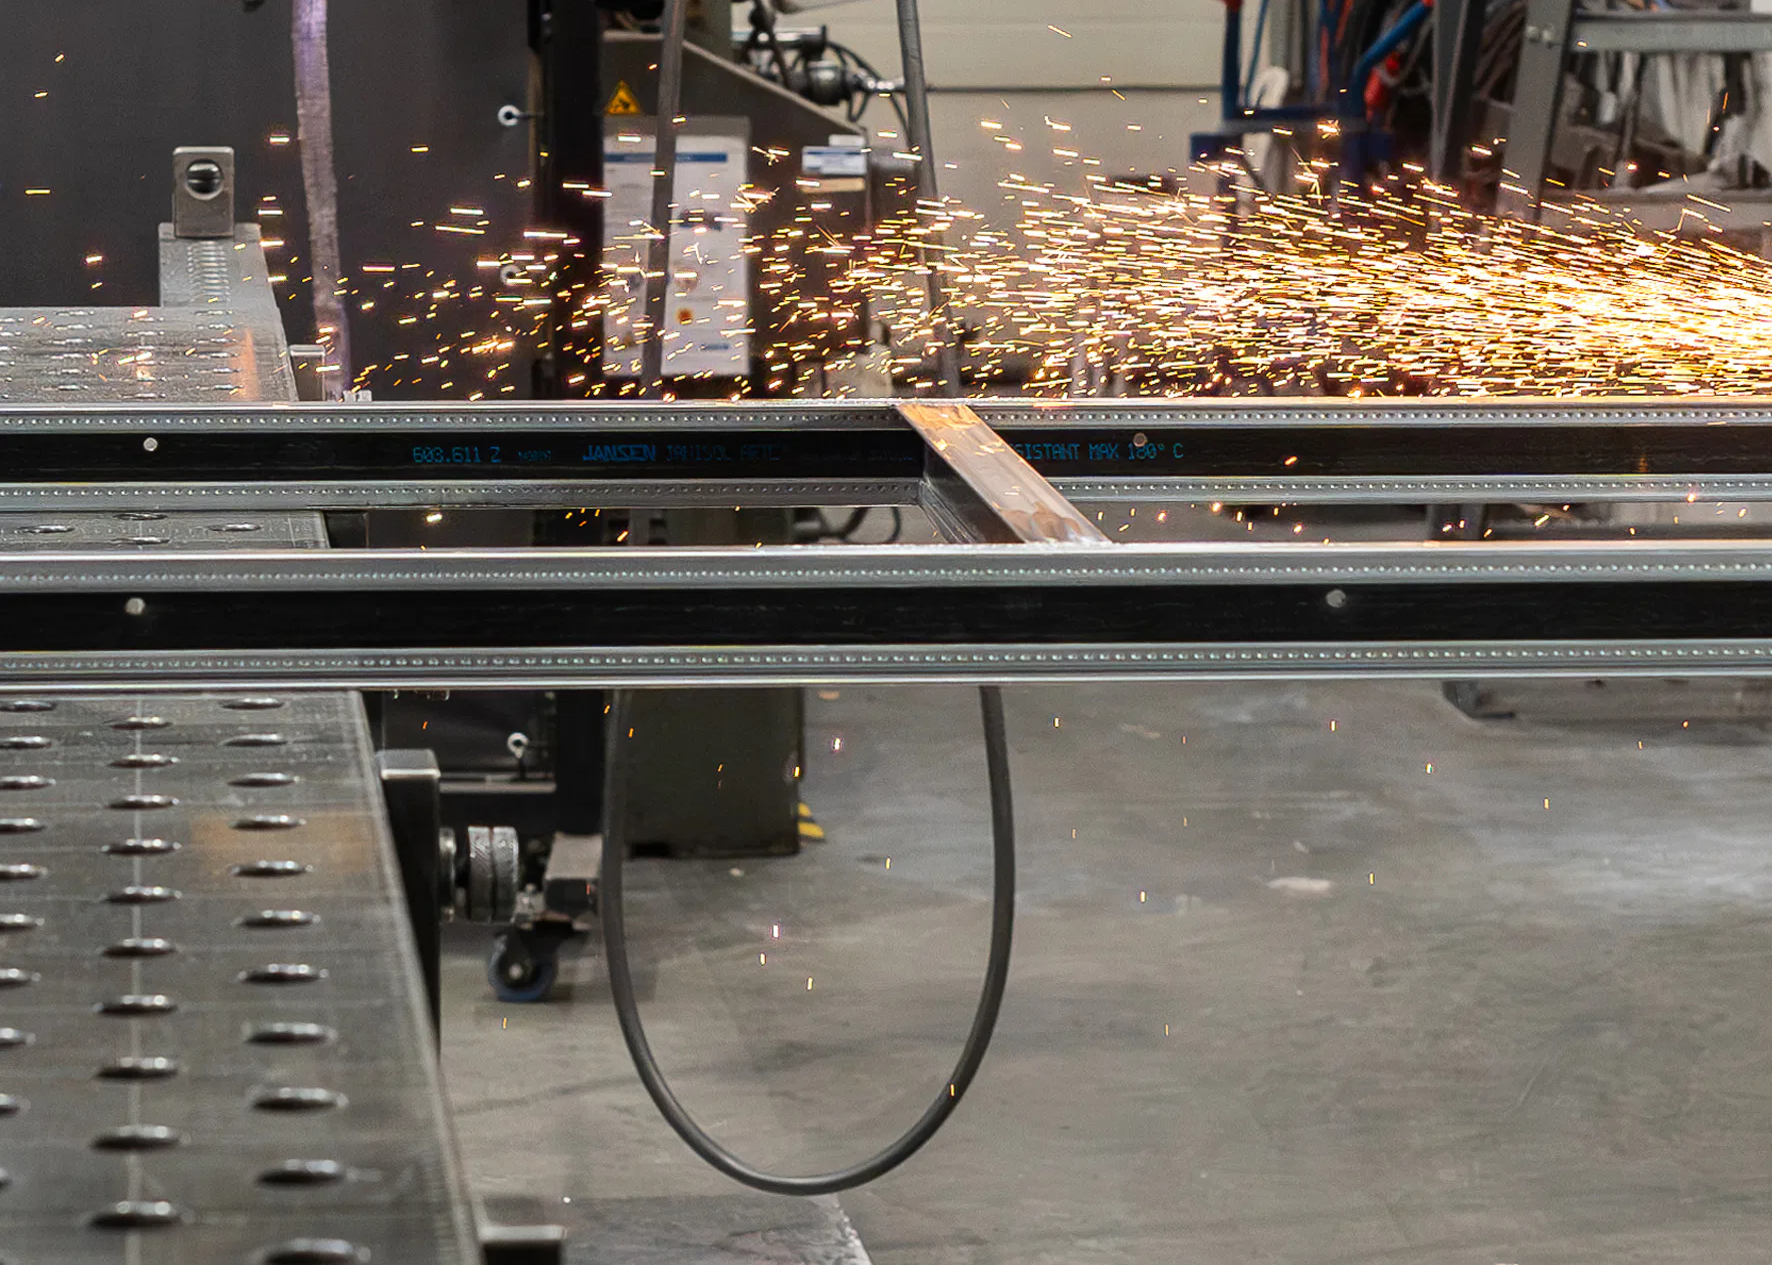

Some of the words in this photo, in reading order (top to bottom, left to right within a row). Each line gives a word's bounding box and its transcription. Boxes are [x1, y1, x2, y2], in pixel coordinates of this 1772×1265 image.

[412, 446, 482, 463] 603.611
[582, 444, 656, 462] JANSEN
[1011, 442, 1080, 461] SISTANT
[1089, 442, 1119, 461] MAX
